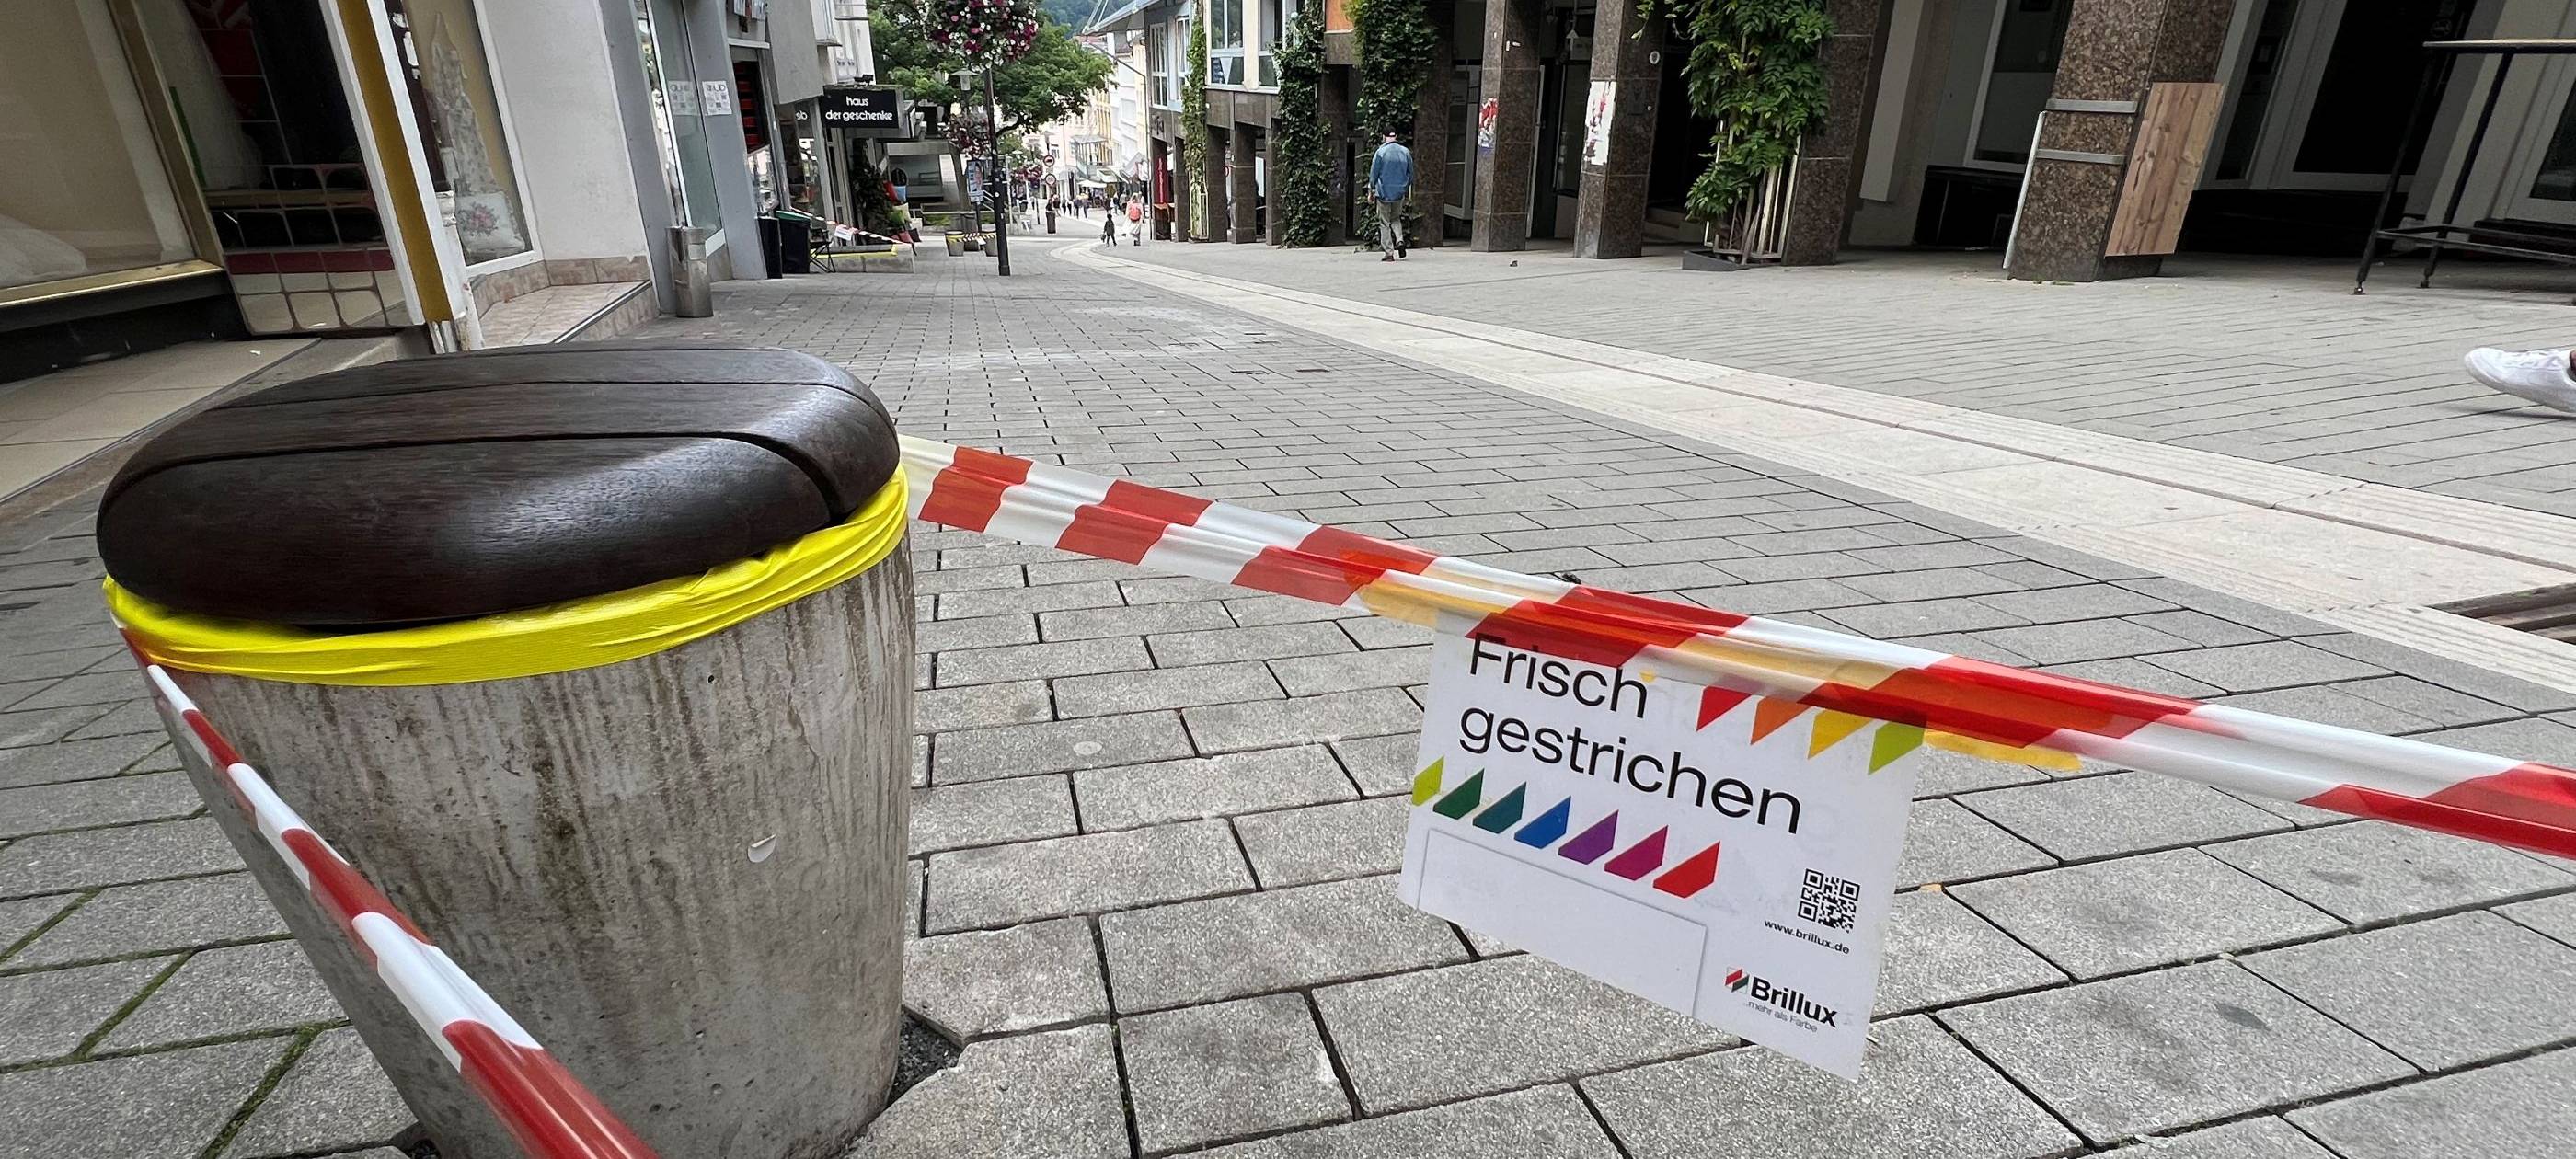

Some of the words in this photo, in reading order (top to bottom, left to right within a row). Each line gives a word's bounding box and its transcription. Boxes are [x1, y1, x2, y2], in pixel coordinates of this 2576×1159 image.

[825, 110, 842, 120] der
[843, 110, 893, 122] geschenke
[845, 96, 869, 107] haus
[1469, 633, 1648, 719] Frisch
[1459, 706, 1801, 835] gestrichen
[1764, 919, 1850, 955] www.brillux.de
[1750, 975, 1838, 1028] Brillux
[1774, 1011, 1788, 1022] als
[1789, 1015, 1818, 1033] Farbe
